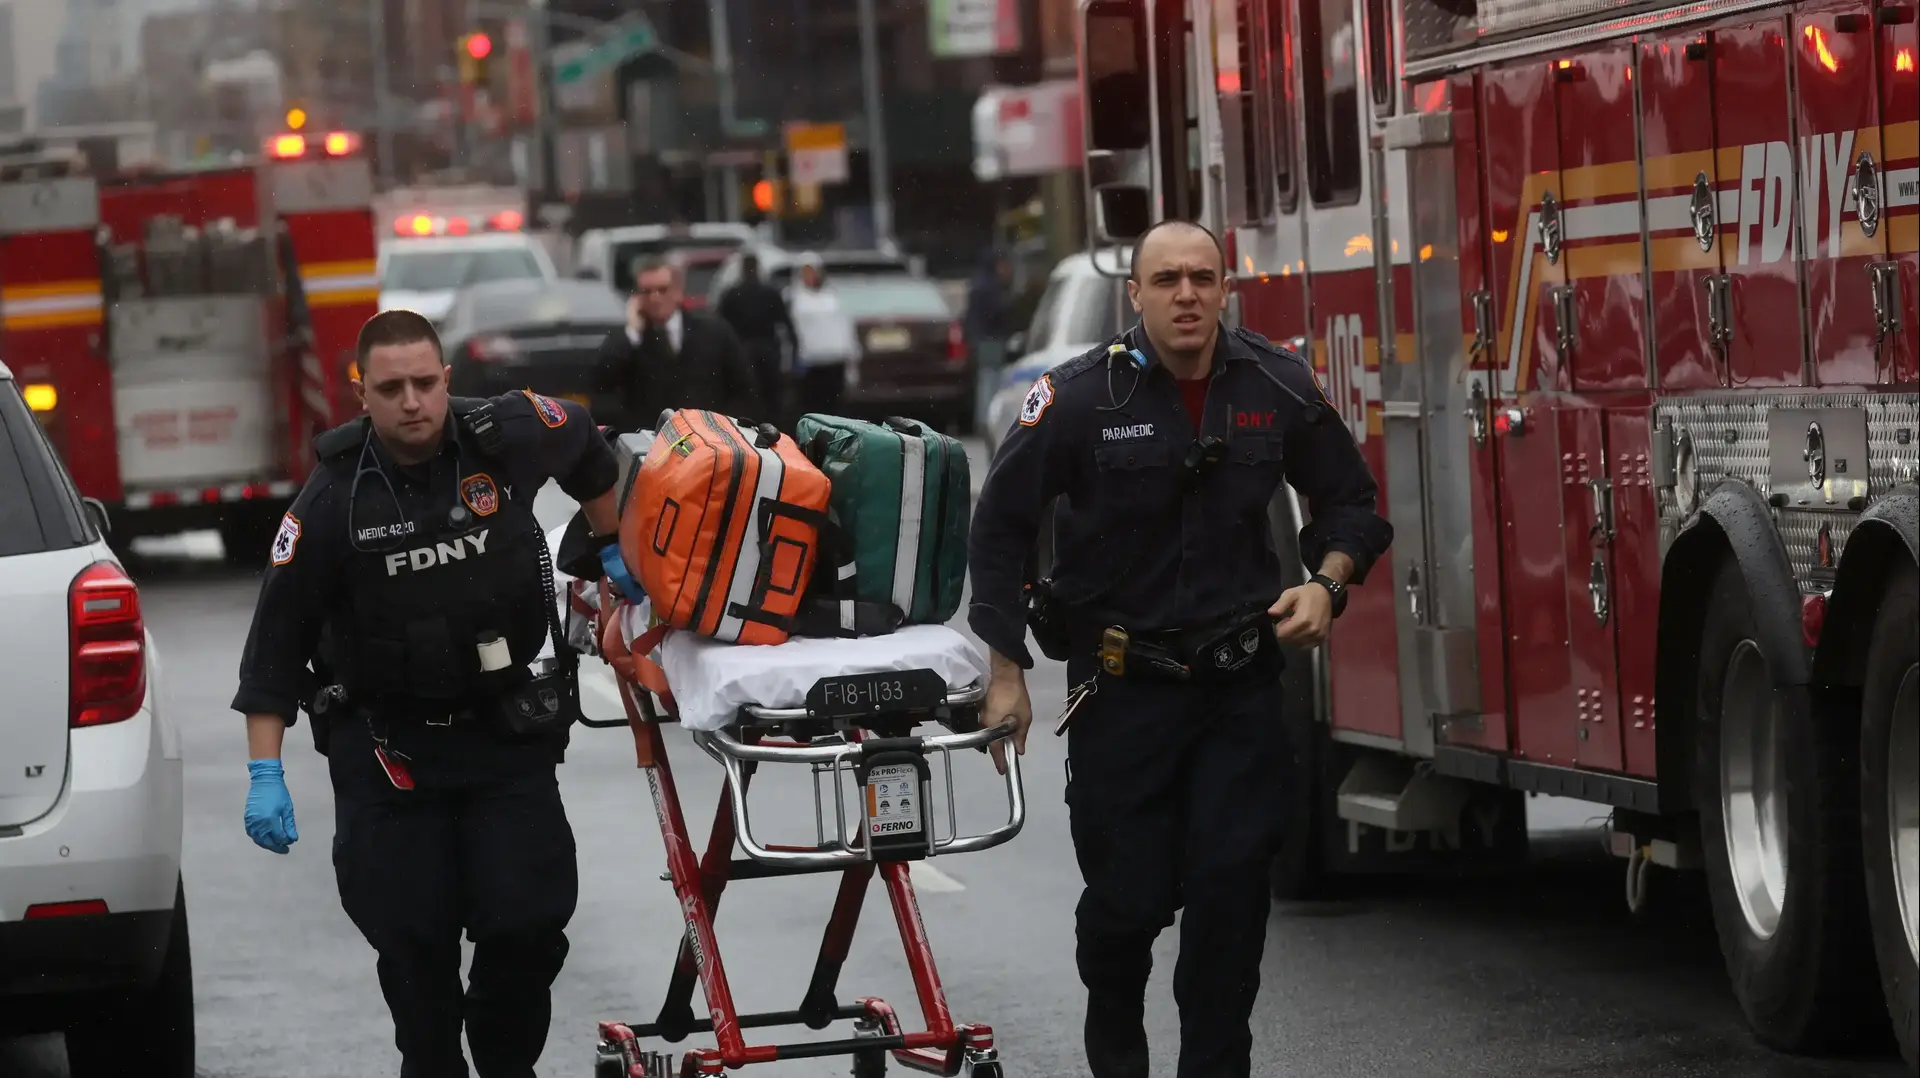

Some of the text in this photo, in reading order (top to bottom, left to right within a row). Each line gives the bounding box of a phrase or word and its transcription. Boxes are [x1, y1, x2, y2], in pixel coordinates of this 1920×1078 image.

[1738, 130, 1855, 266] FDNY
[1326, 313, 1367, 444] 109
[1236, 411, 1275, 428] DNY
[1102, 423, 1155, 441] PARAMEDIC
[358, 526, 388, 541] MEDIC
[385, 529, 489, 576] FDNY
[25, 765, 46, 778] LT
[881, 820, 914, 832] FERNO
